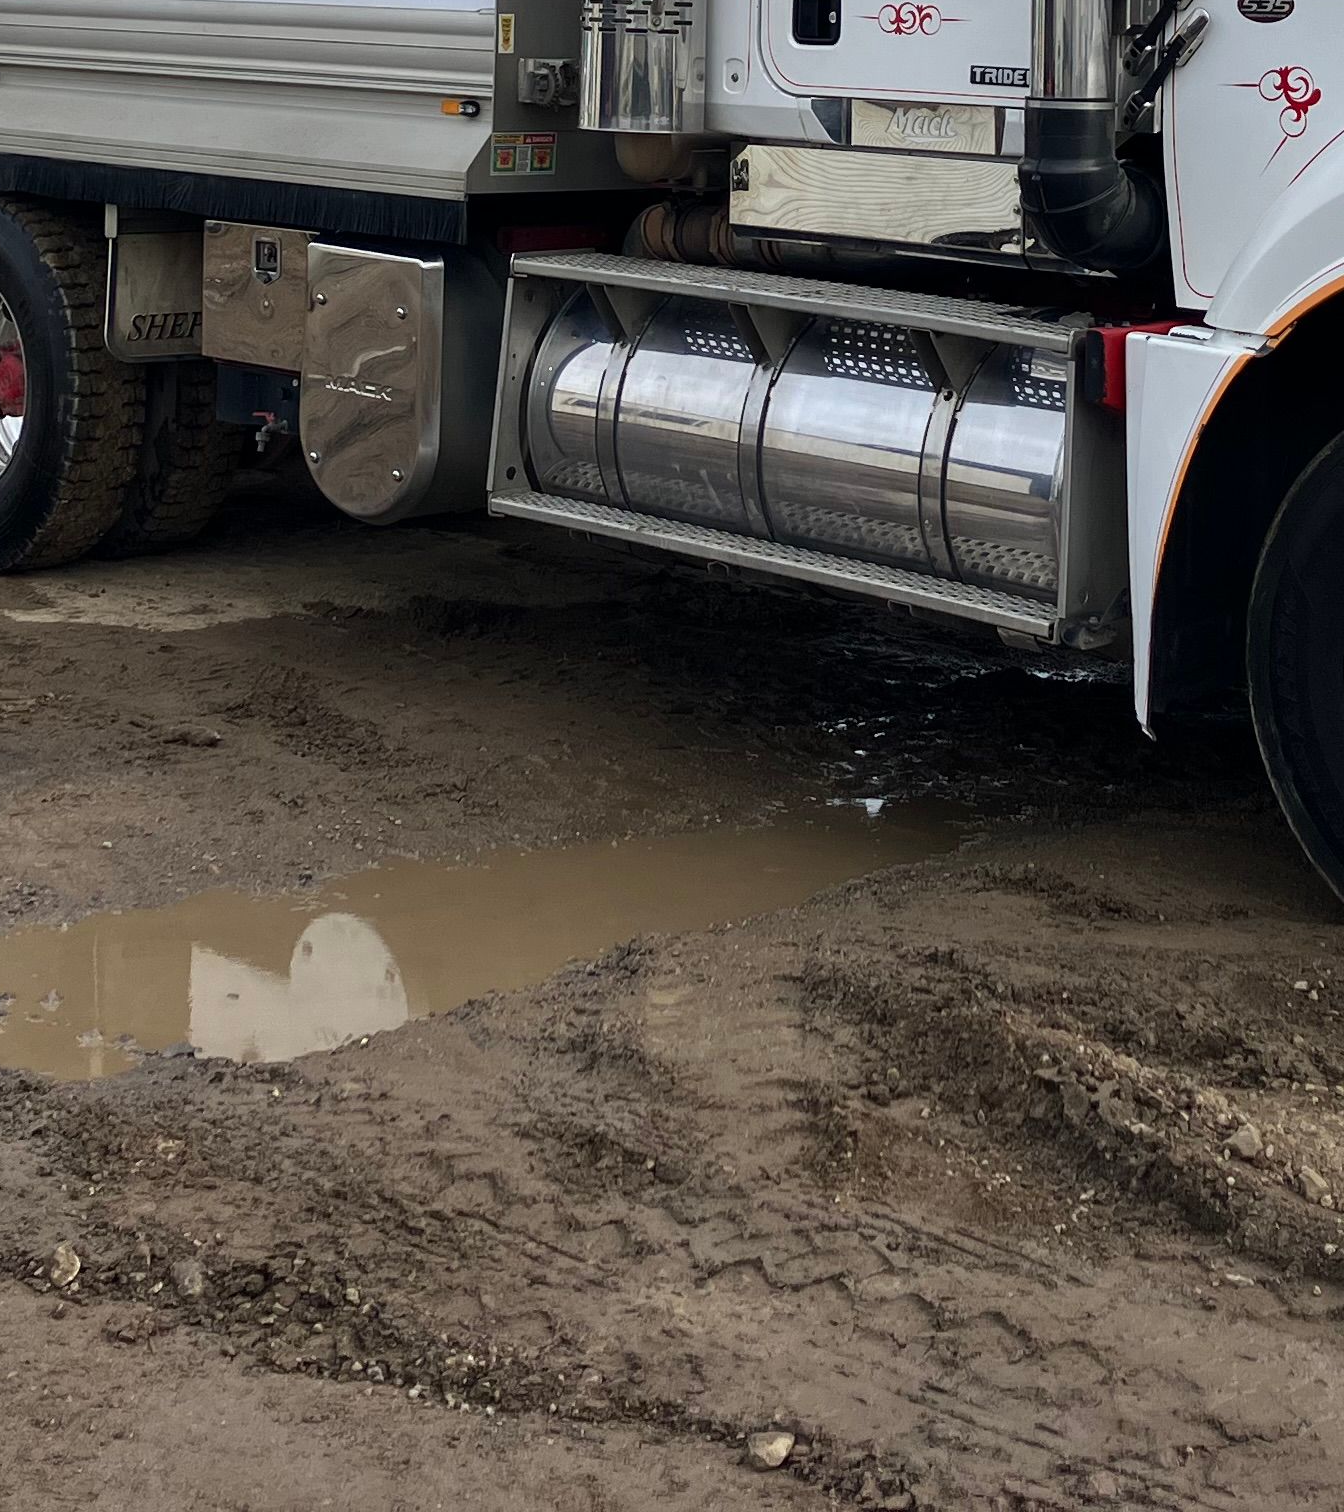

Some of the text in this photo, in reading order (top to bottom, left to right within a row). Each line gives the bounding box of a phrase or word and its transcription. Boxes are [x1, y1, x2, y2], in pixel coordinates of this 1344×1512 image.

[972, 66, 1030, 86] TRIDE
[886, 107, 957, 140] Mack
[324, 374, 392, 402] MACK
